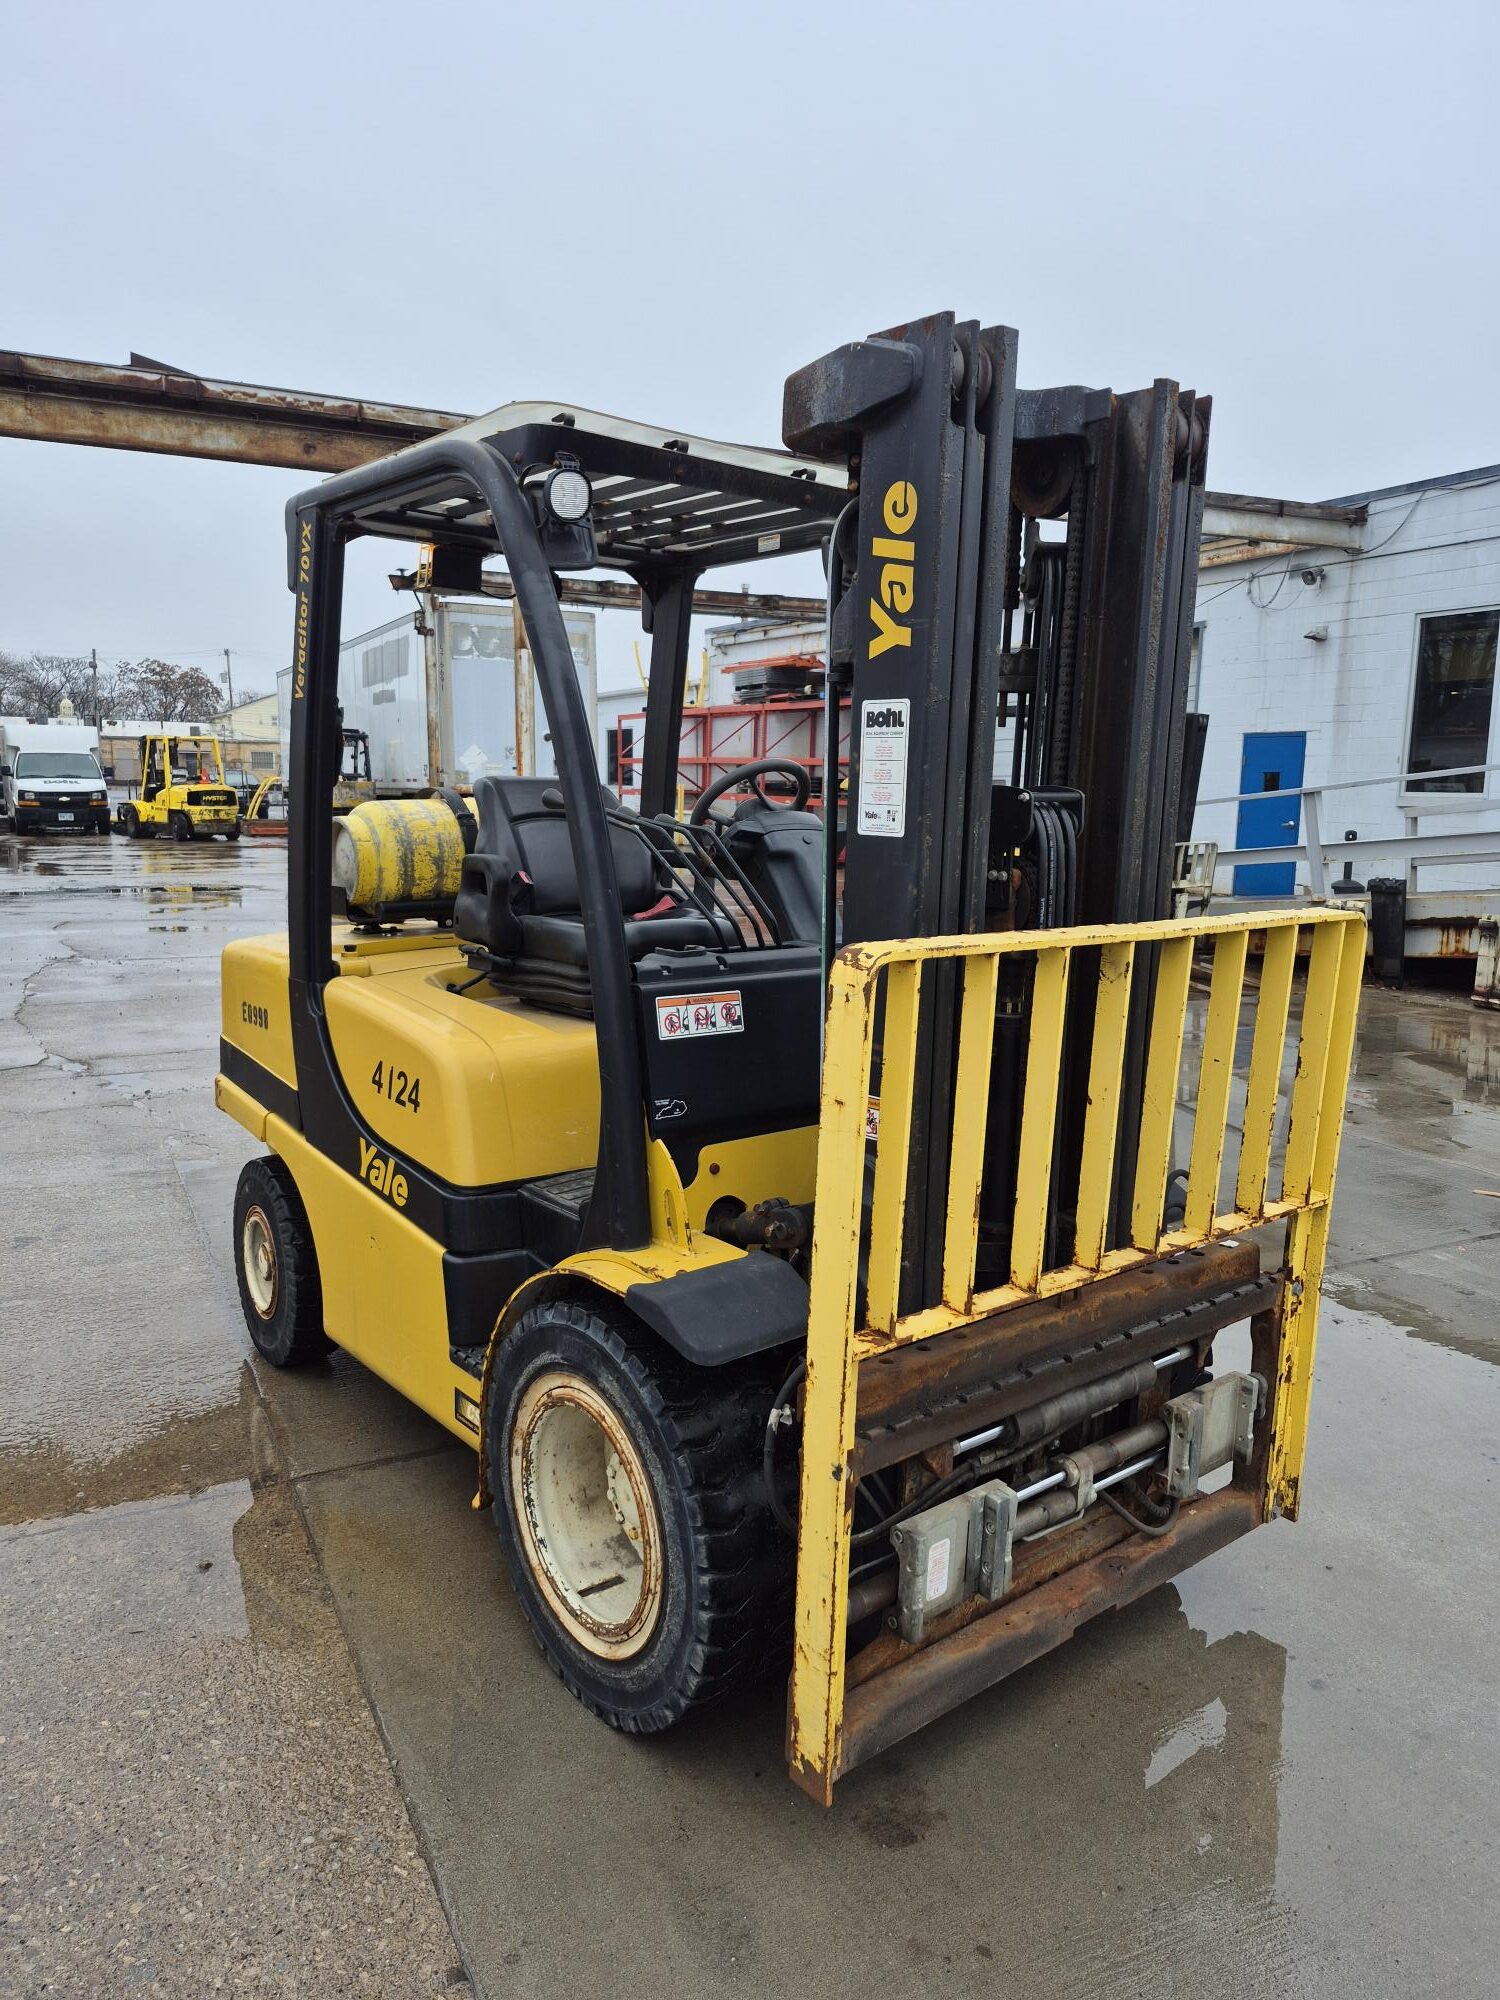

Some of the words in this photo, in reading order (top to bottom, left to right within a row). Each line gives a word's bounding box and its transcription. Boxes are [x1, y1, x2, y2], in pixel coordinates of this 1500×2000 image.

[300, 519, 312, 584] 70VX
[868, 480, 918, 660] Yale
[294, 592, 309, 700] Veracitor
[371, 1060, 421, 1113] 4124
[359, 1137, 409, 1207] Yale
